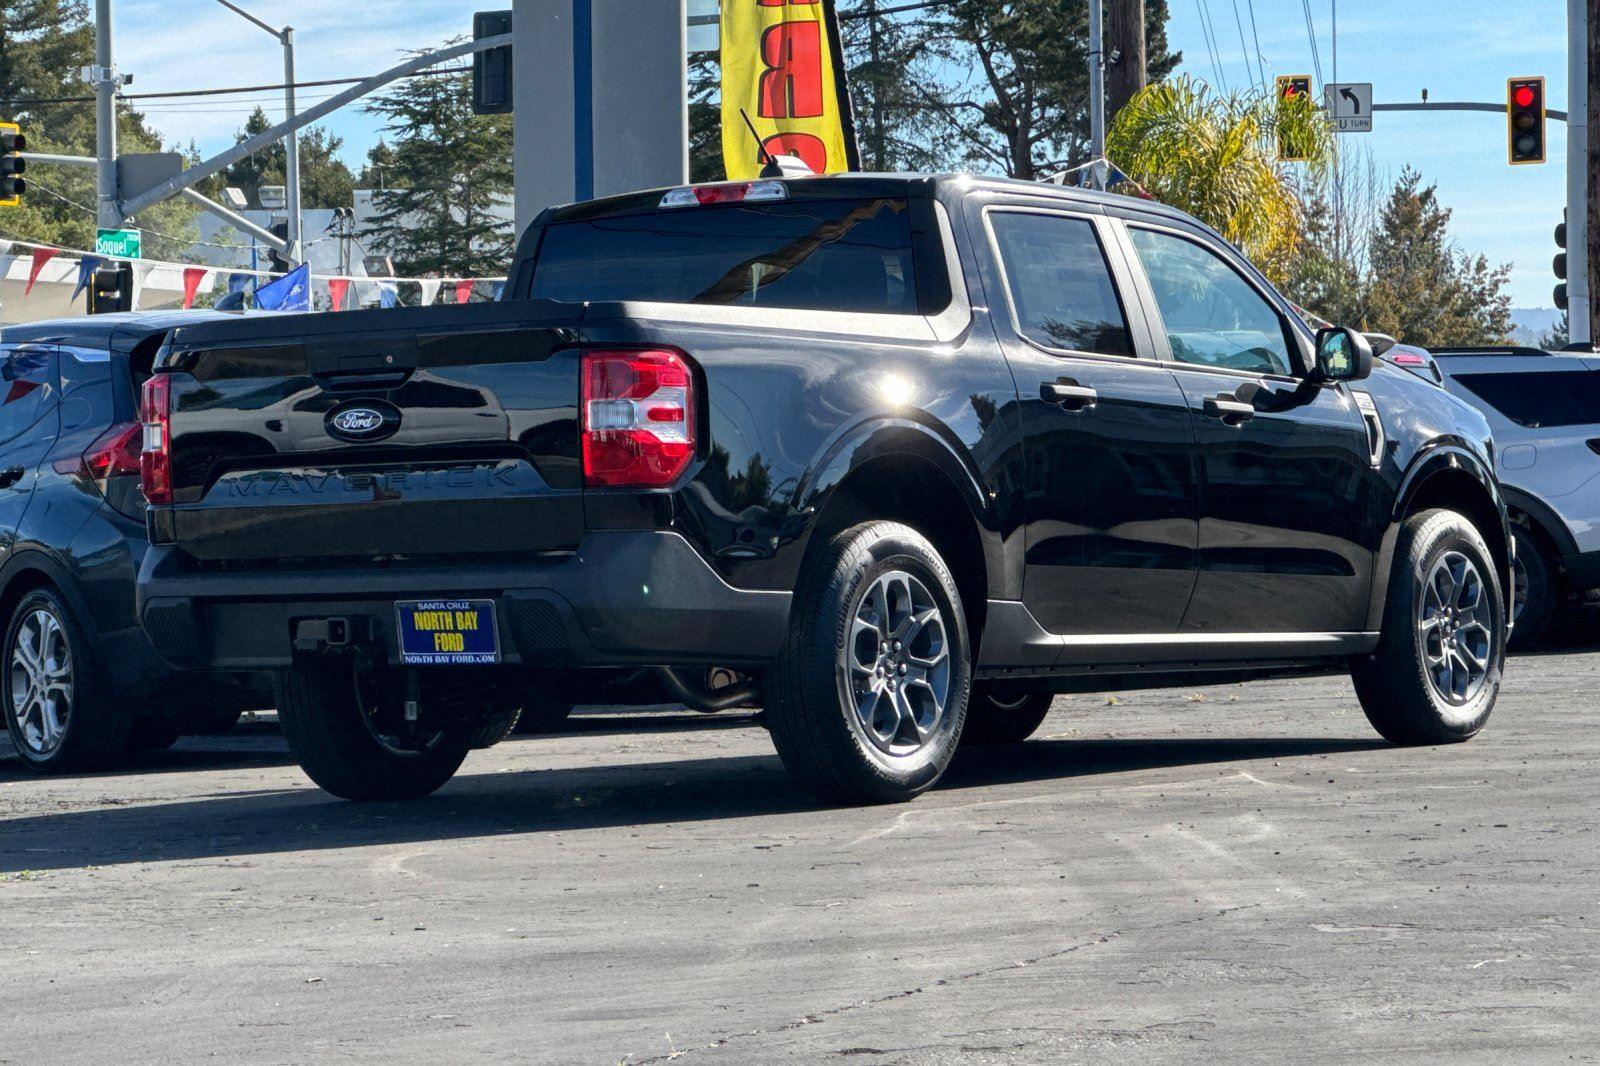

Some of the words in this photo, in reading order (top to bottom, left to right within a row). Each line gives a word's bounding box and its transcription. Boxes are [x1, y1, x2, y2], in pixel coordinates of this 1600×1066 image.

[98, 237, 127, 257] Soquel
[342, 412, 373, 428] Ford
[228, 464, 518, 498] MAVERICK
[418, 602, 446, 610] SANTA
[446, 602, 470, 610] CRUZ
[413, 611, 454, 631] NORTH
[455, 611, 479, 631] BAY
[434, 632, 465, 652] FORD
[405, 655, 433, 664] NORTH
[435, 655, 450, 664] BAY
